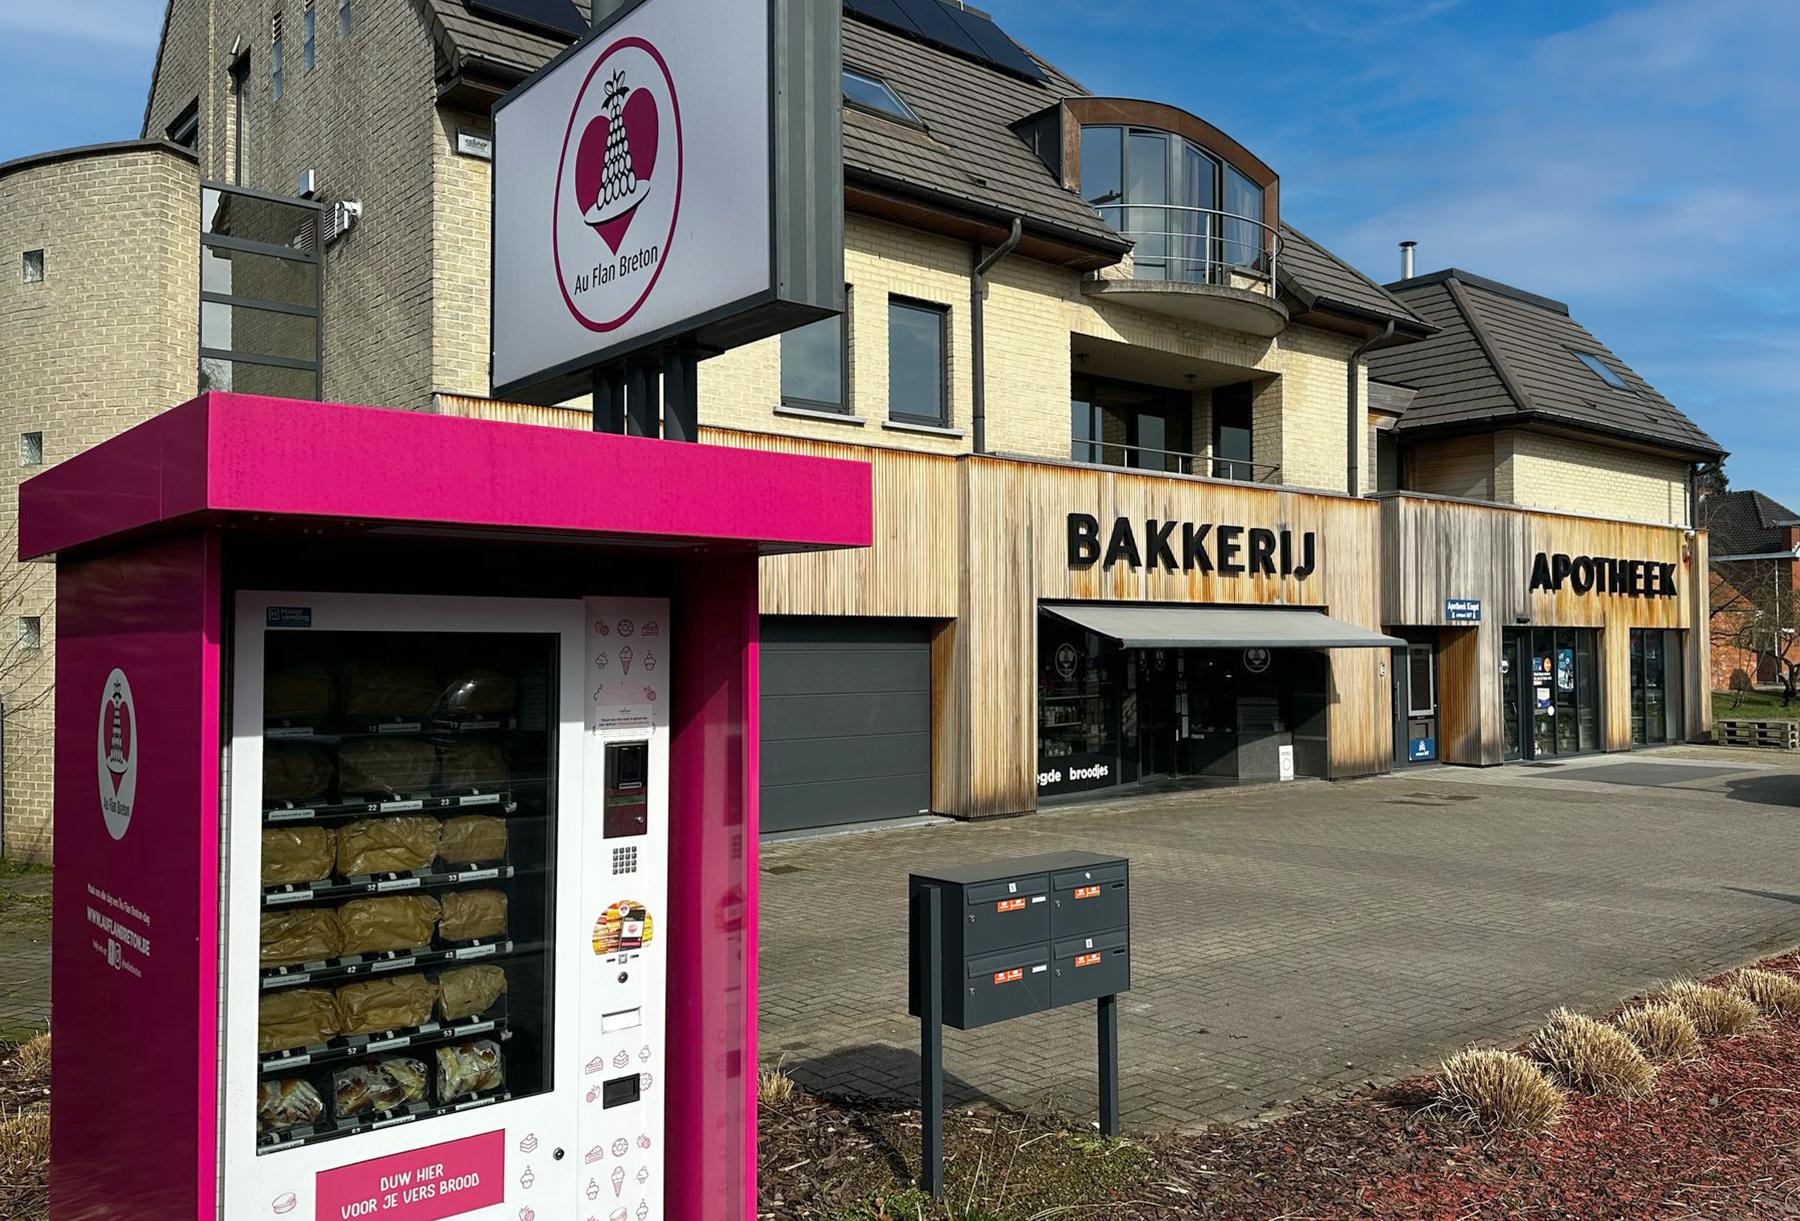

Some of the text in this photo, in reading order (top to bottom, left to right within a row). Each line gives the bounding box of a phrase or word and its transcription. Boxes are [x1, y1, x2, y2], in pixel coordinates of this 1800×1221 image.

[574, 245, 658, 295] Au Flan Breton
[1067, 512, 1315, 578] BAKKERIJ
[1529, 552, 1677, 598] APOTHEEK
[1069, 763, 1109, 780] broodjes
[368, 804, 377, 812] 22
[441, 798, 450, 806] 23
[367, 884, 376, 892] 32
[448, 874, 457, 882] 33
[380, 1163, 444, 1192] DUW HIER
[341, 1172, 480, 1220] VOOR JE VERS BROOD
